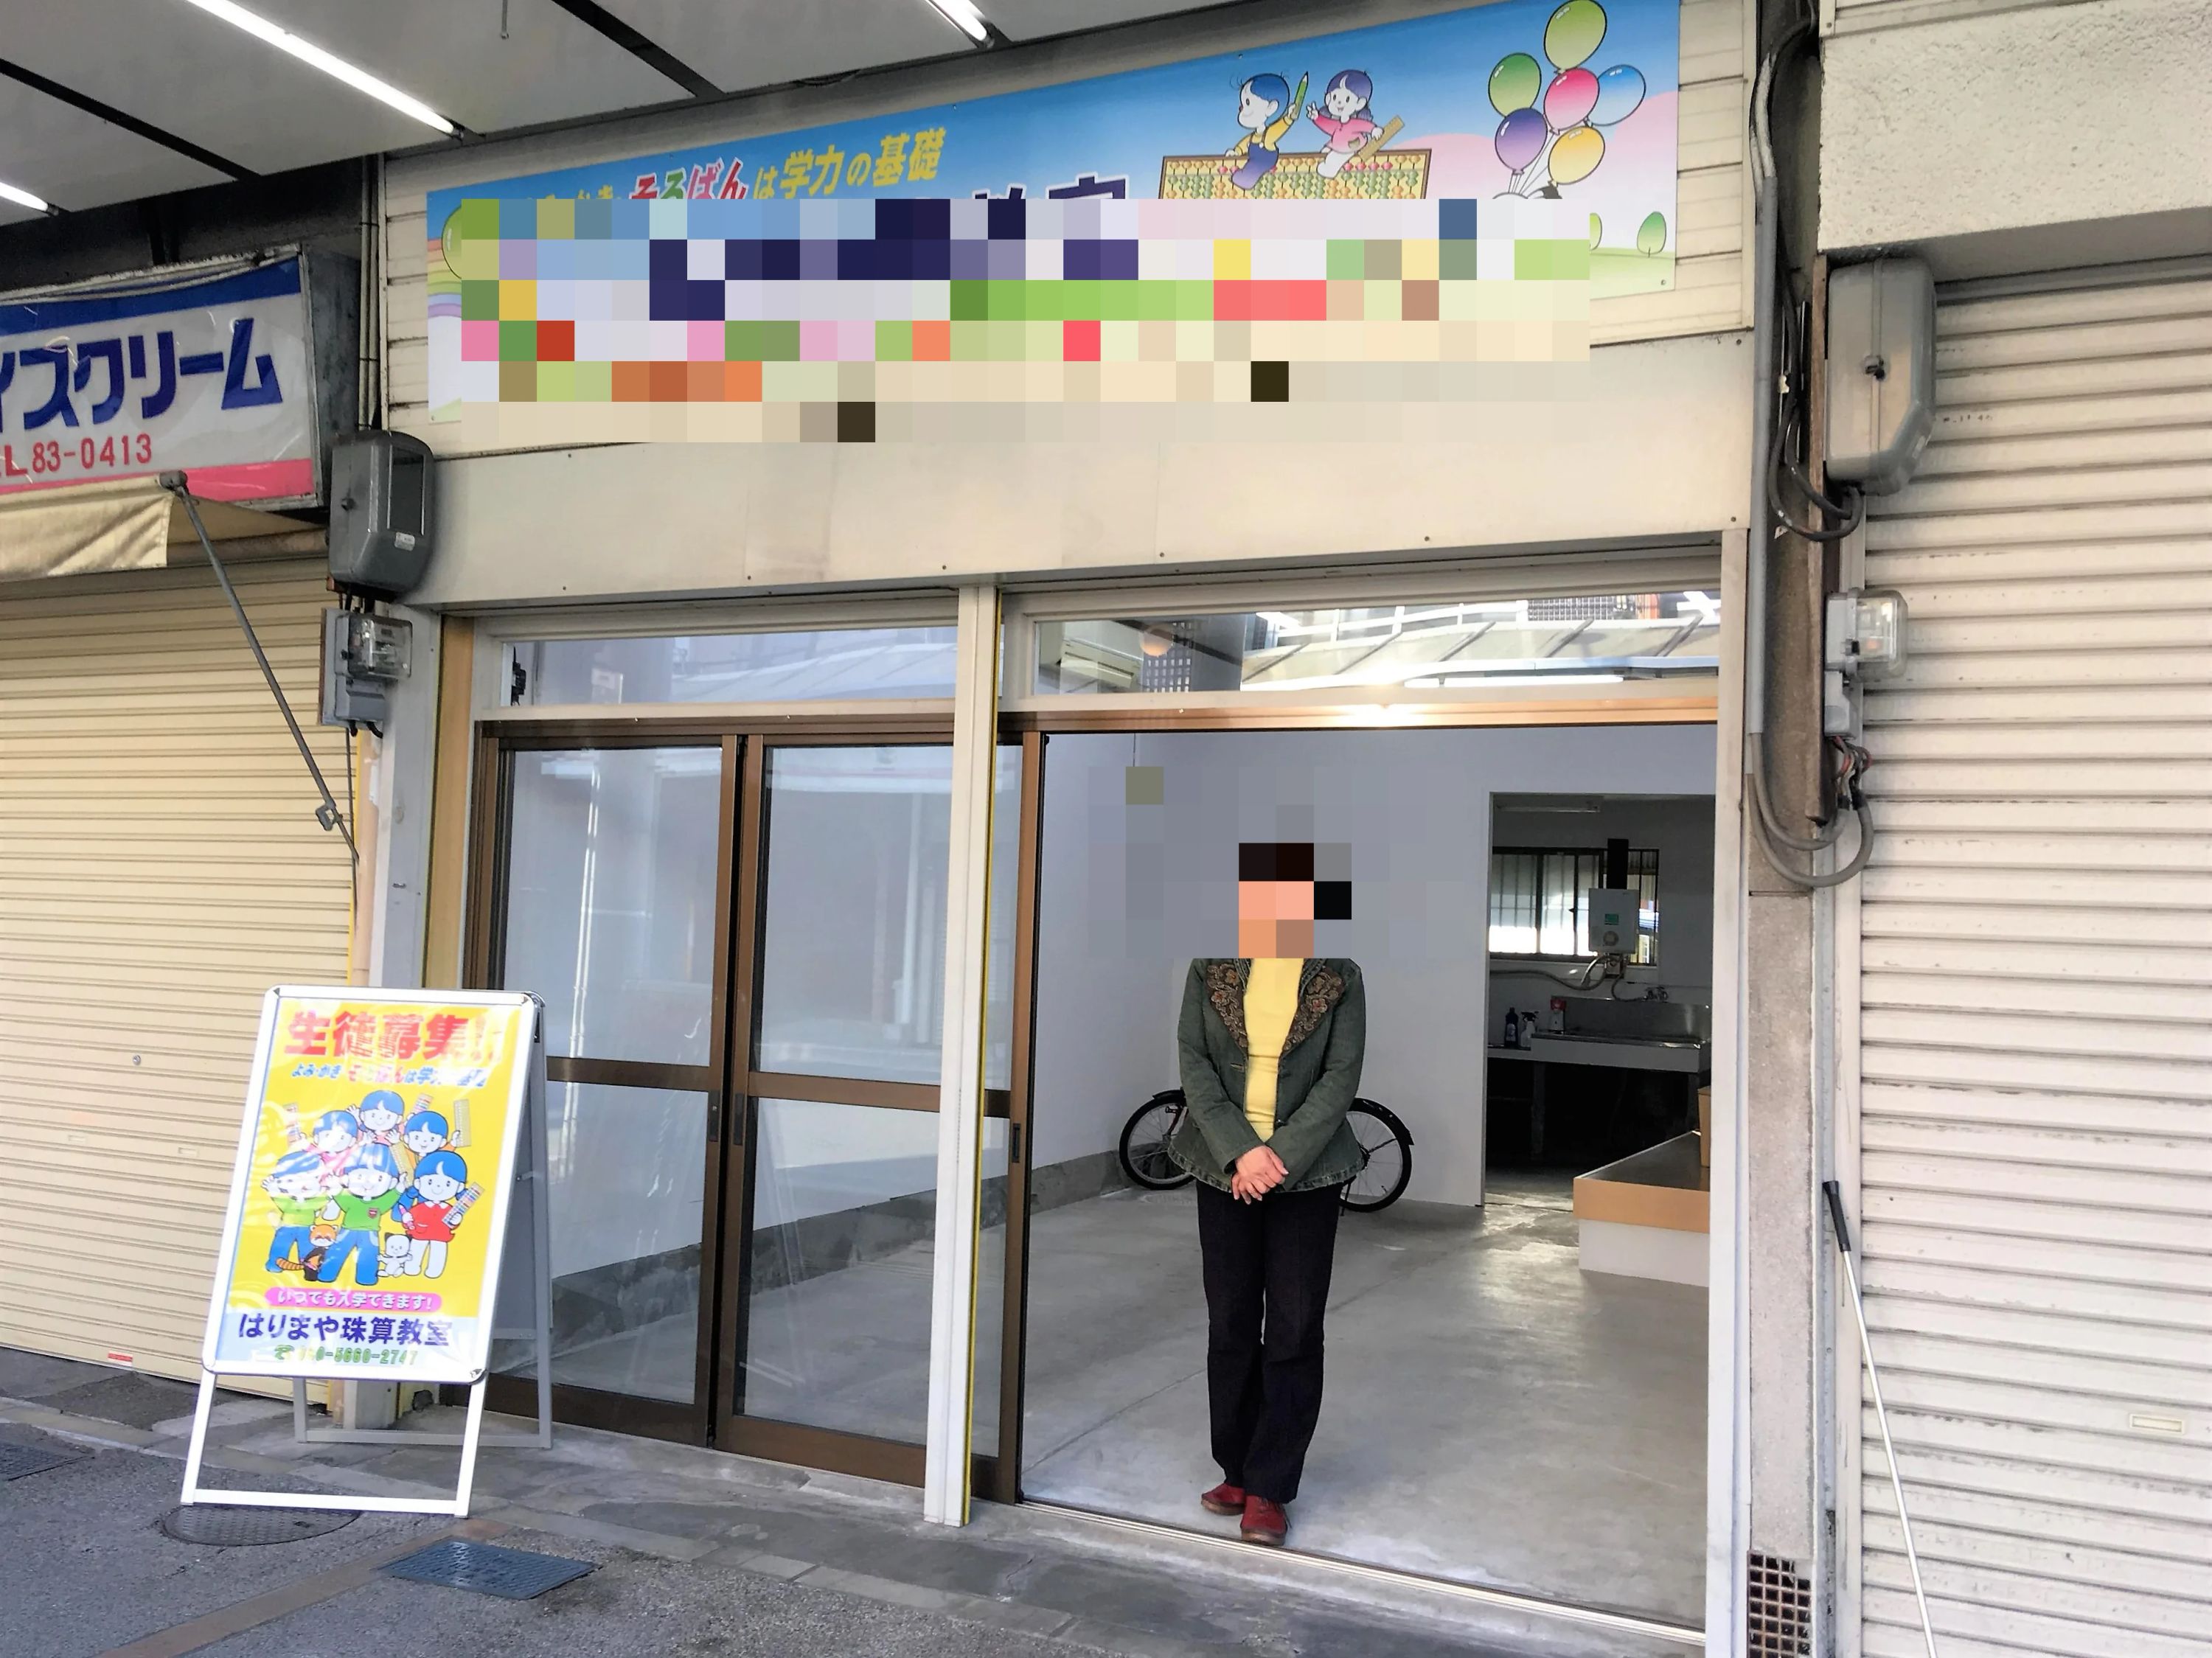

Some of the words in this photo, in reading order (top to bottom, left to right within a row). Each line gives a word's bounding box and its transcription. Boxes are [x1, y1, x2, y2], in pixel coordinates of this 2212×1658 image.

[32, 433, 152, 474] 83-0413
[277, 1289, 432, 1311] いつでも入学できます!
[238, 1313, 453, 1346] はりまや珠算教室
